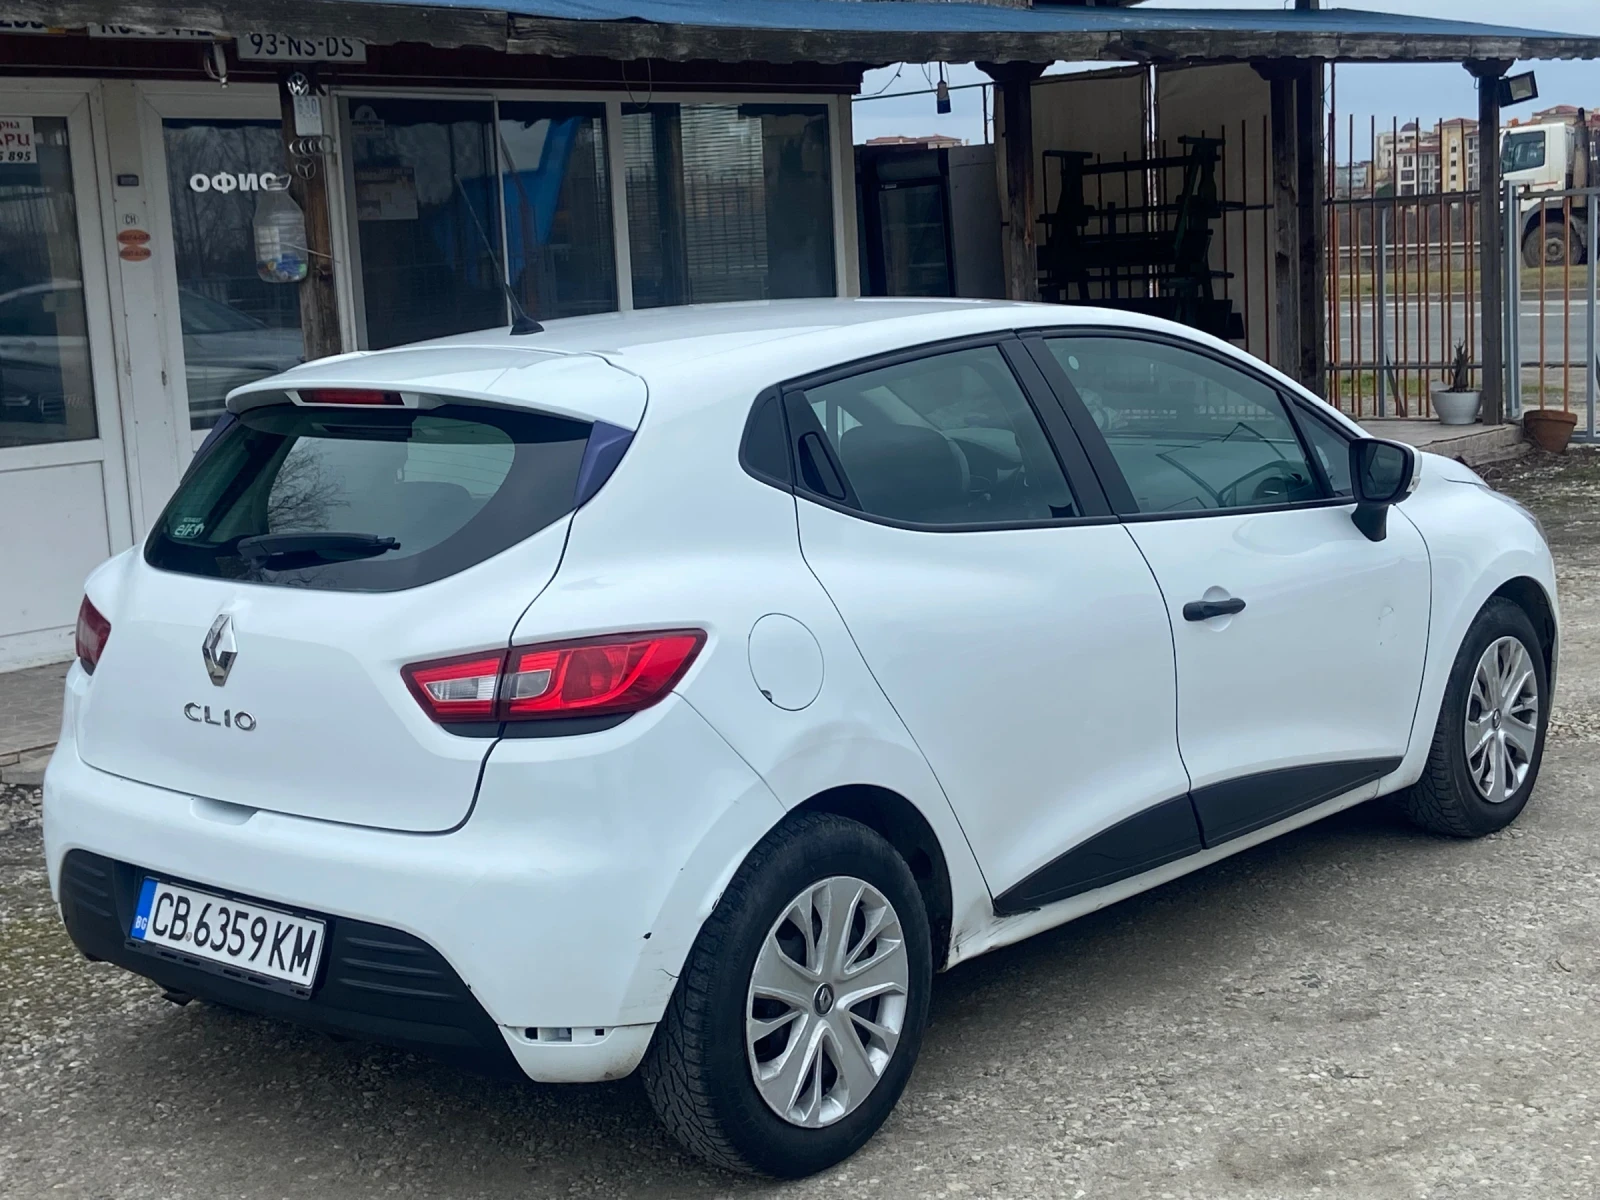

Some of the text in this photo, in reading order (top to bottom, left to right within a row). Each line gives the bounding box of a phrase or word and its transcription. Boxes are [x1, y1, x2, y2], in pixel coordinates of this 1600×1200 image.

[250, 33, 354, 58] 93-NS-DS
[8, 151, 31, 162] 895
[125, 213, 137, 225] CH
[184, 702, 257, 732] CLIO
[135, 915, 148, 930] BG
